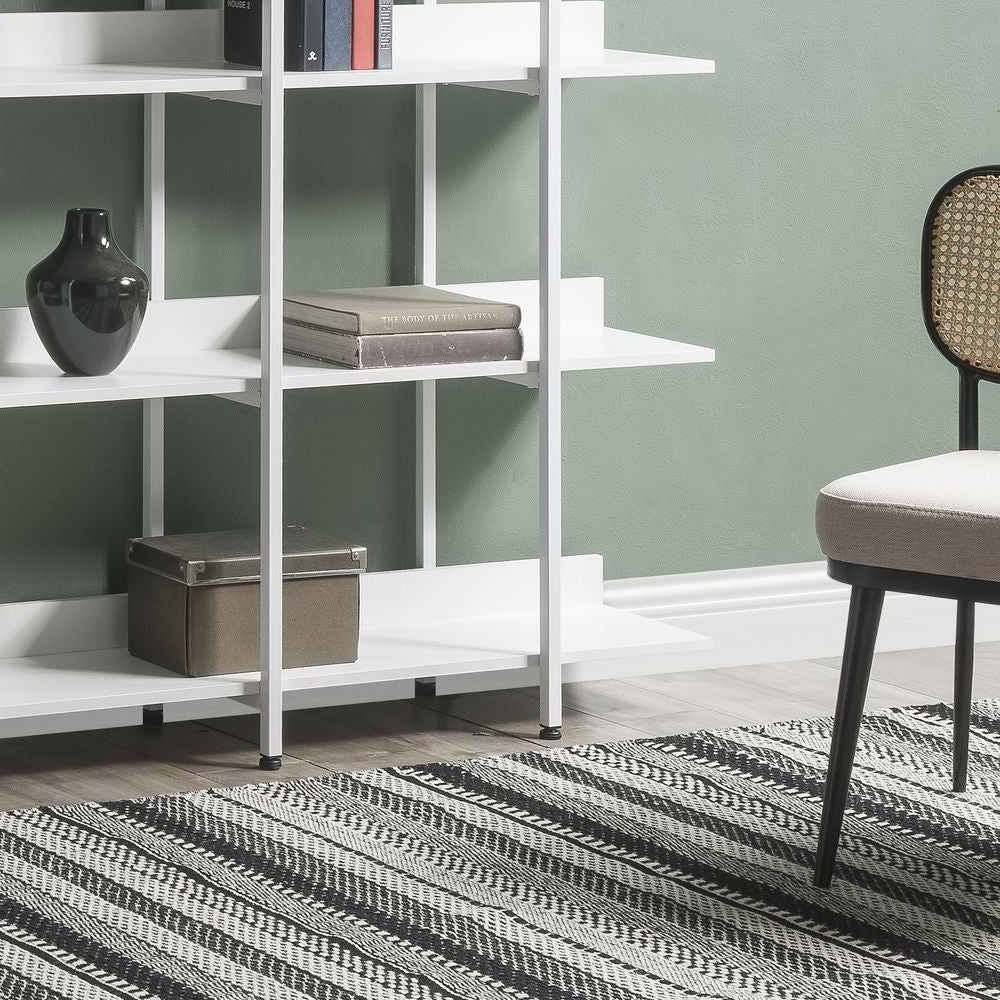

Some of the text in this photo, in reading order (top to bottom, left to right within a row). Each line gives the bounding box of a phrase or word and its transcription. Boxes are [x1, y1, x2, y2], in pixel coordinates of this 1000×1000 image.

[227, 0, 251, 9] HOUSE 2
[380, 1, 392, 51] FURNITURE
[381, 315, 399, 324] THE
[402, 314, 426, 323] BODY
[427, 314, 440, 322] OF
[462, 311, 498, 321] ARTISAN
